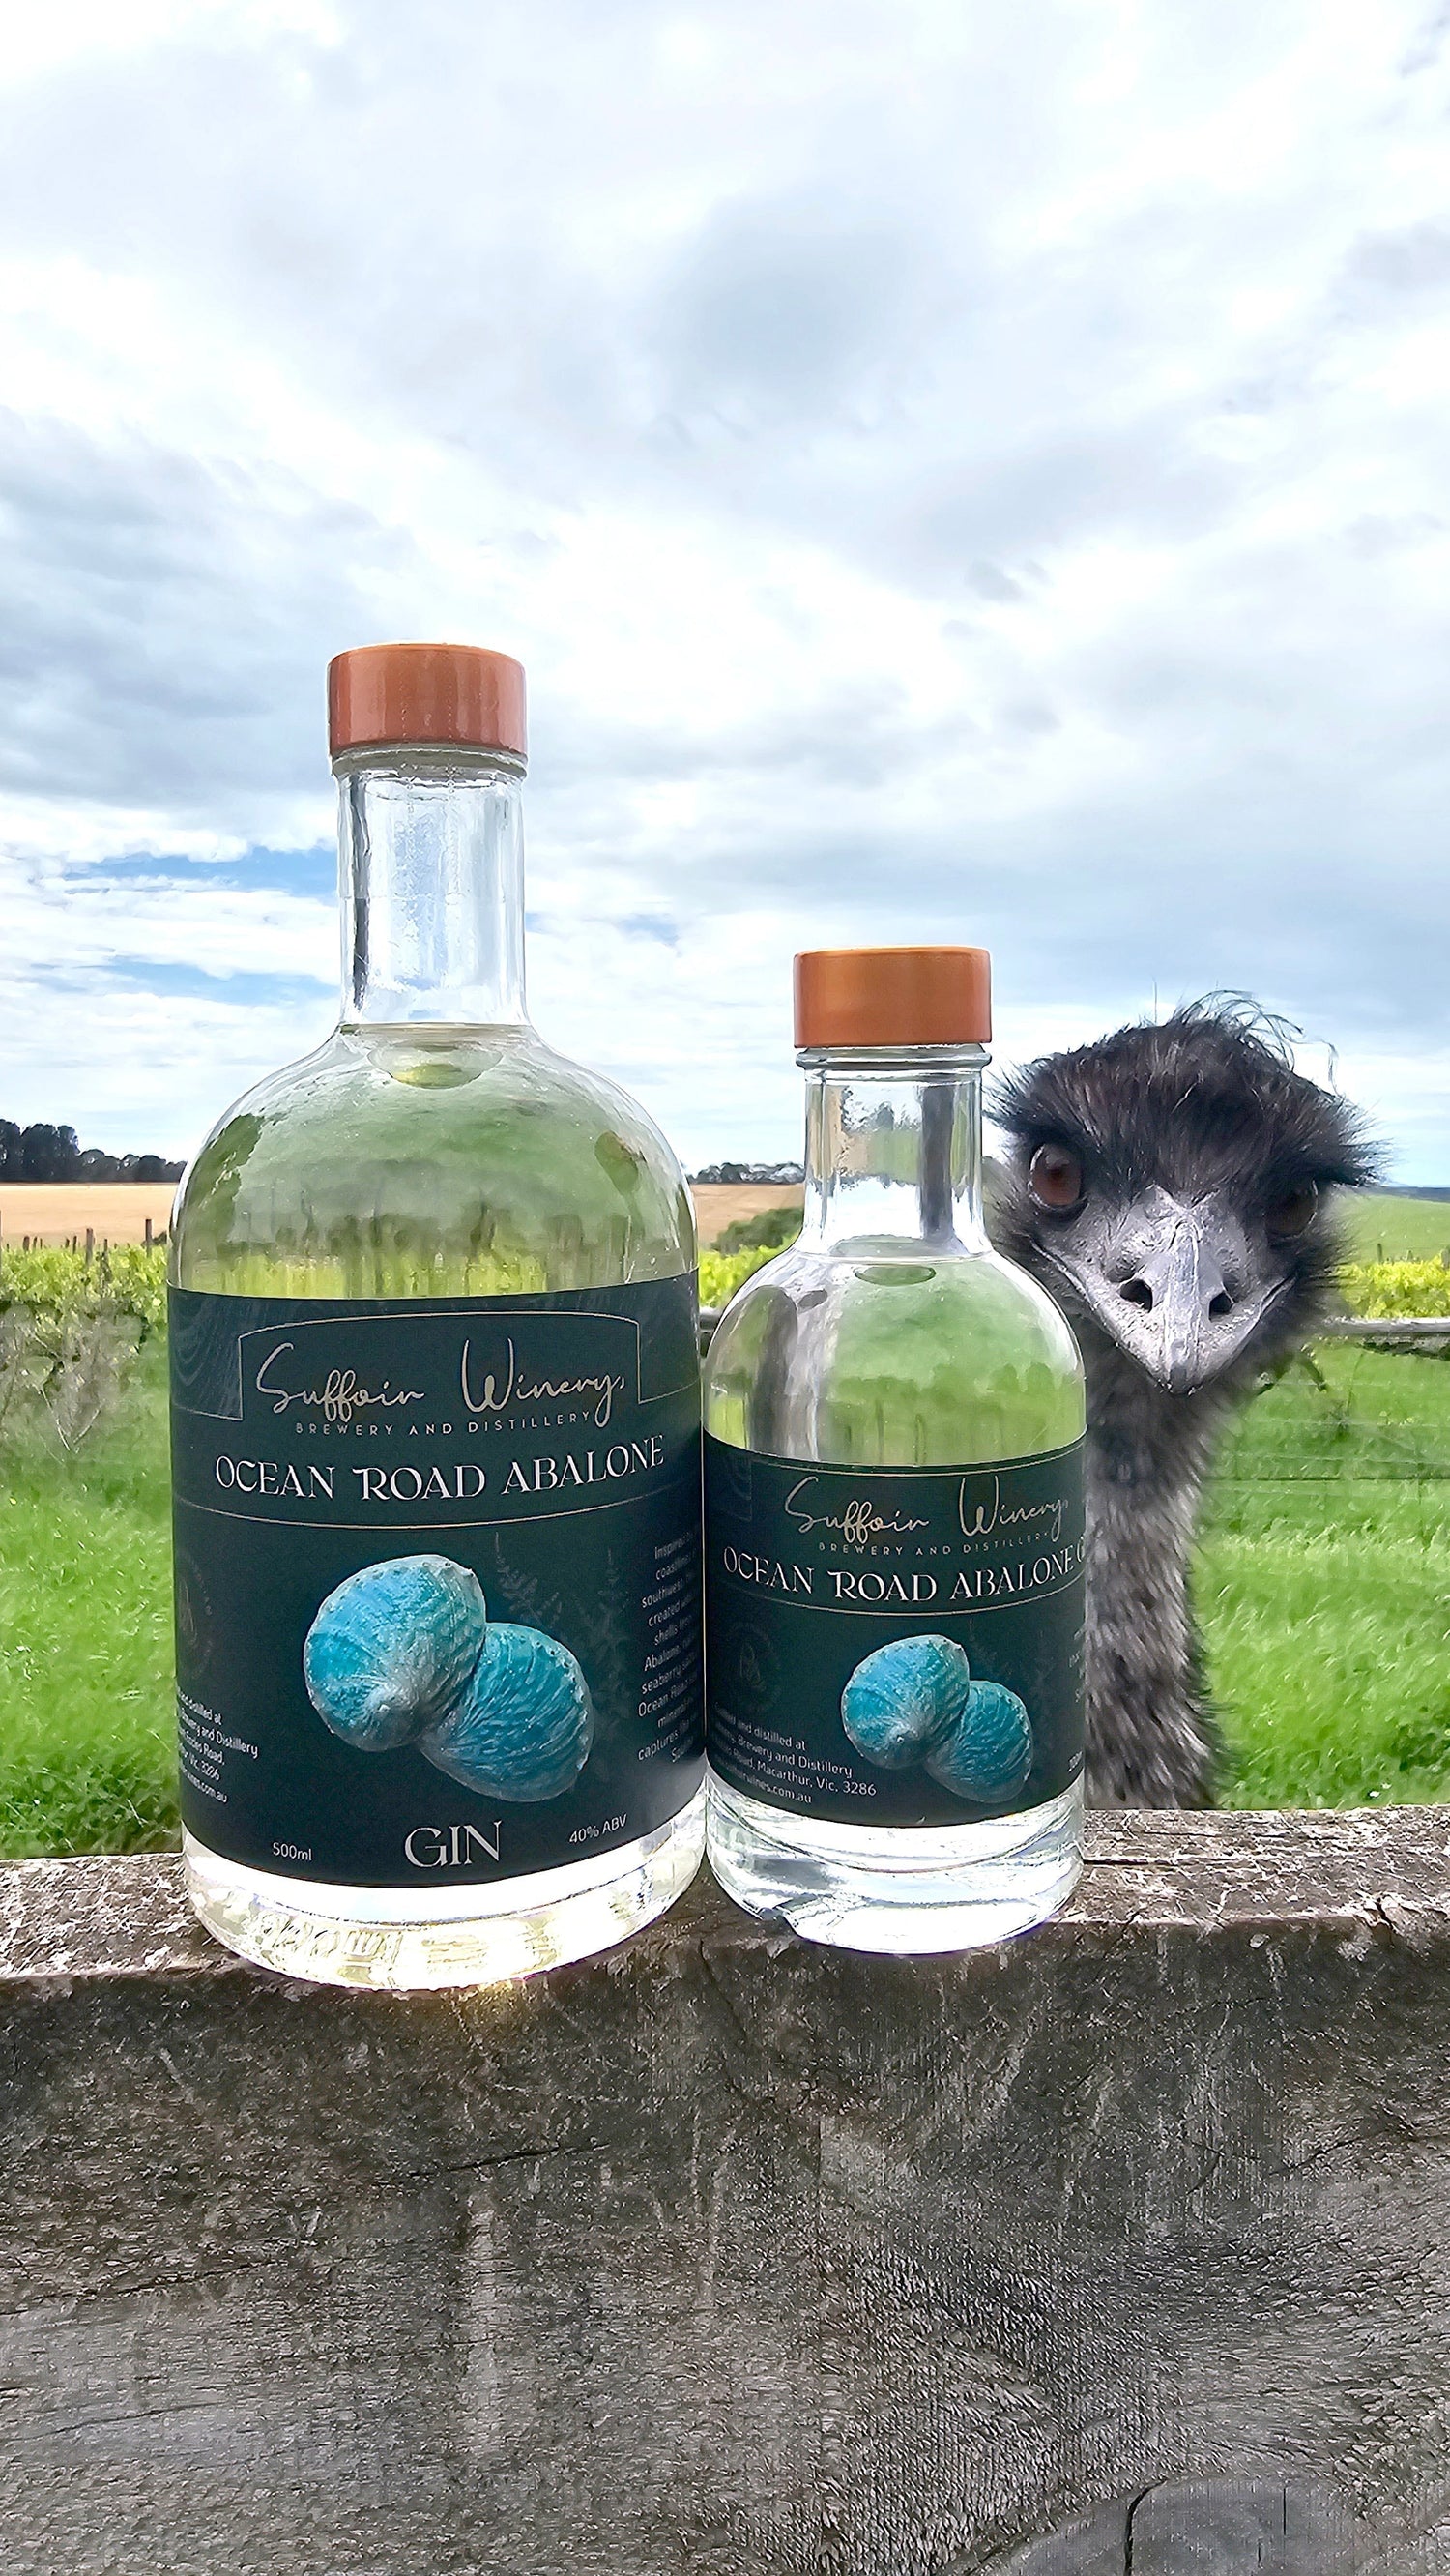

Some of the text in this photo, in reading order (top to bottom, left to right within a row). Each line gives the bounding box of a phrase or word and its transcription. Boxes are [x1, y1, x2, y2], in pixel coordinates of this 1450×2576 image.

[296, 1411, 590, 1436] BREWERY AND DISTILLERY
[216, 1434, 665, 1500] OCEAN ROAD ABALONE
[818, 1541, 904, 1556] BREWERY
[915, 1546, 952, 1556] AND
[724, 1546, 815, 1595] OCEAN
[827, 1570, 937, 1602] ROAD
[949, 1544, 1074, 1601] ABALONE
[648, 1599, 681, 1627] created
[638, 1693, 669, 1717] Ocean
[214, 1713, 222, 1726] at
[201, 1727, 215, 1741] and
[216, 1730, 258, 1760] Distillery
[638, 1730, 679, 1761] captures
[754, 1726, 793, 1748] distilled
[795, 1740, 806, 1752] at
[738, 1734, 773, 1762] Brewery
[774, 1752, 796, 1766] and
[798, 1755, 854, 1779] Distillery
[815, 1775, 839, 1794] Vic.
[842, 1780, 878, 1797] 3286
[568, 1813, 628, 1845] 40% ABV
[272, 1840, 313, 1862] 500ml
[404, 1820, 503, 1868] GIN
